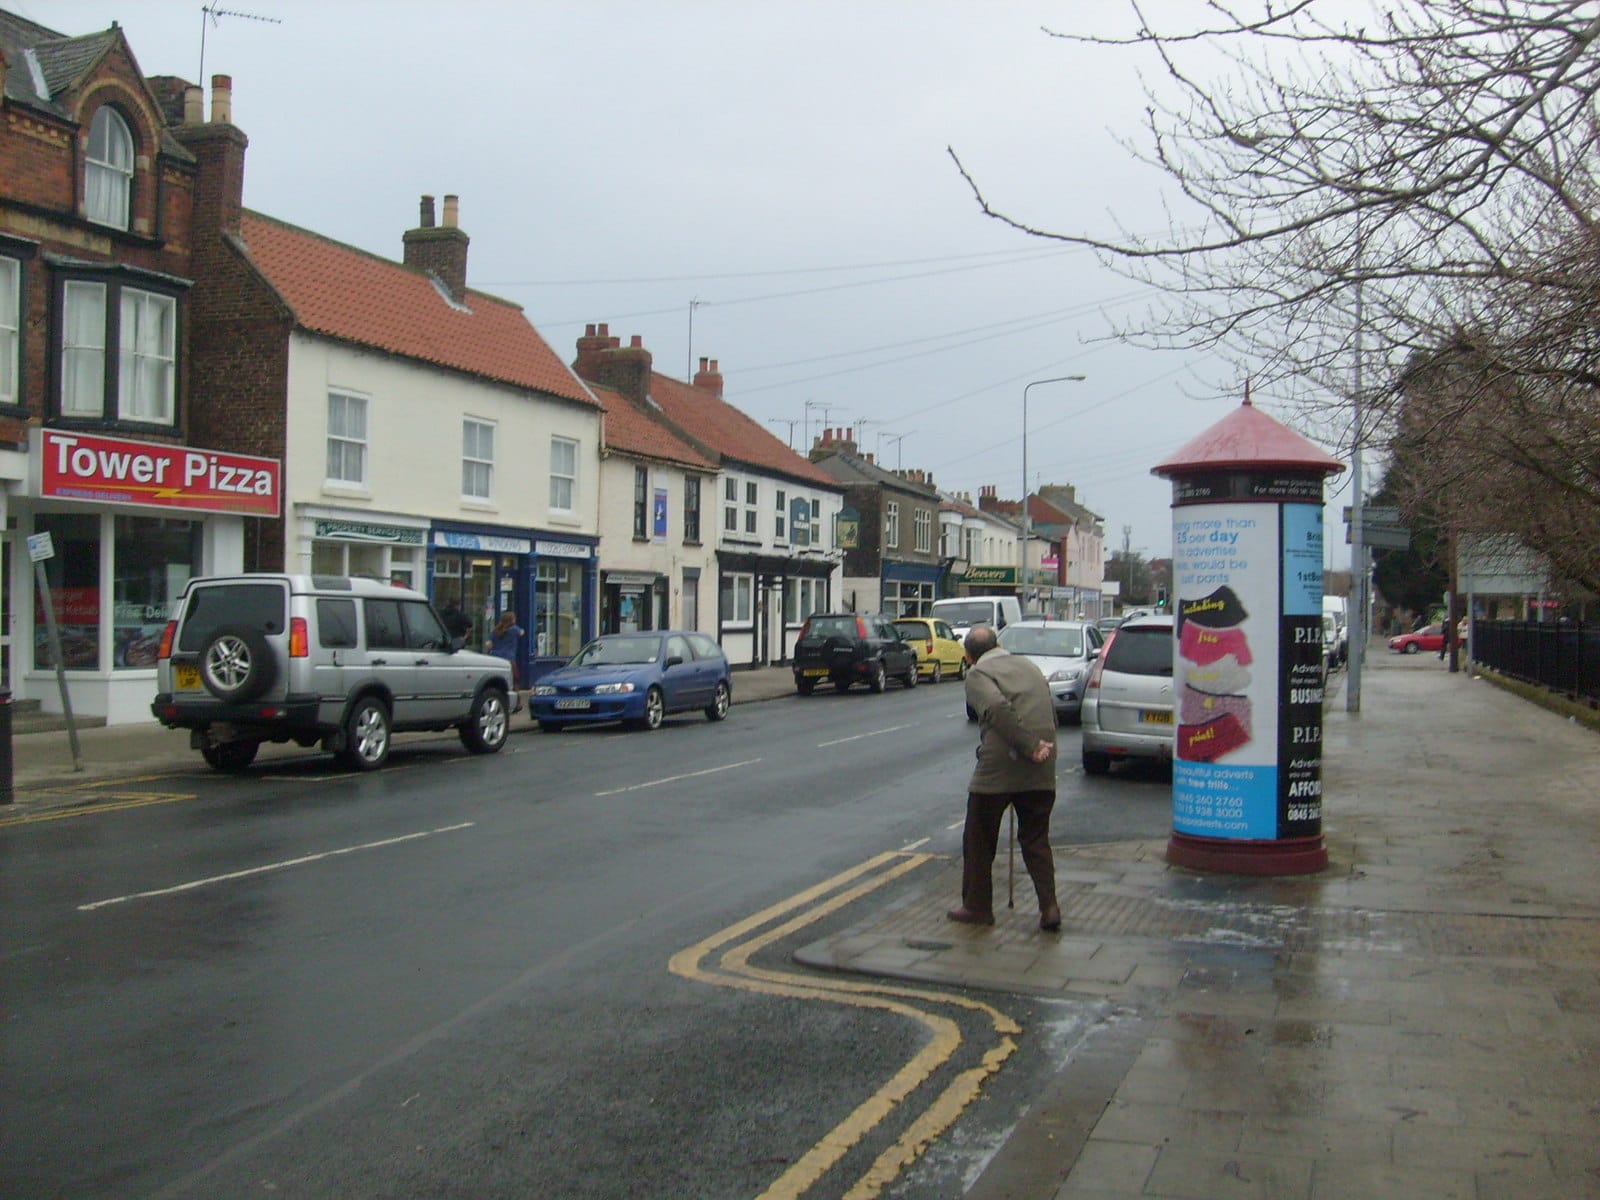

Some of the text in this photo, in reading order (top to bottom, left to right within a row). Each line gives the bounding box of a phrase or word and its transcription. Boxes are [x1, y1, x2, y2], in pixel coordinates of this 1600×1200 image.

[50, 436, 273, 496] Tower Pizza
[1193, 519, 1222, 529] more
[1226, 518, 1256, 529] than
[1209, 530, 1240, 545] day
[1192, 559, 1225, 570] would
[1230, 559, 1248, 569] be
[1213, 770, 1254, 780] adverts
[1215, 796, 1243, 807] 2760
